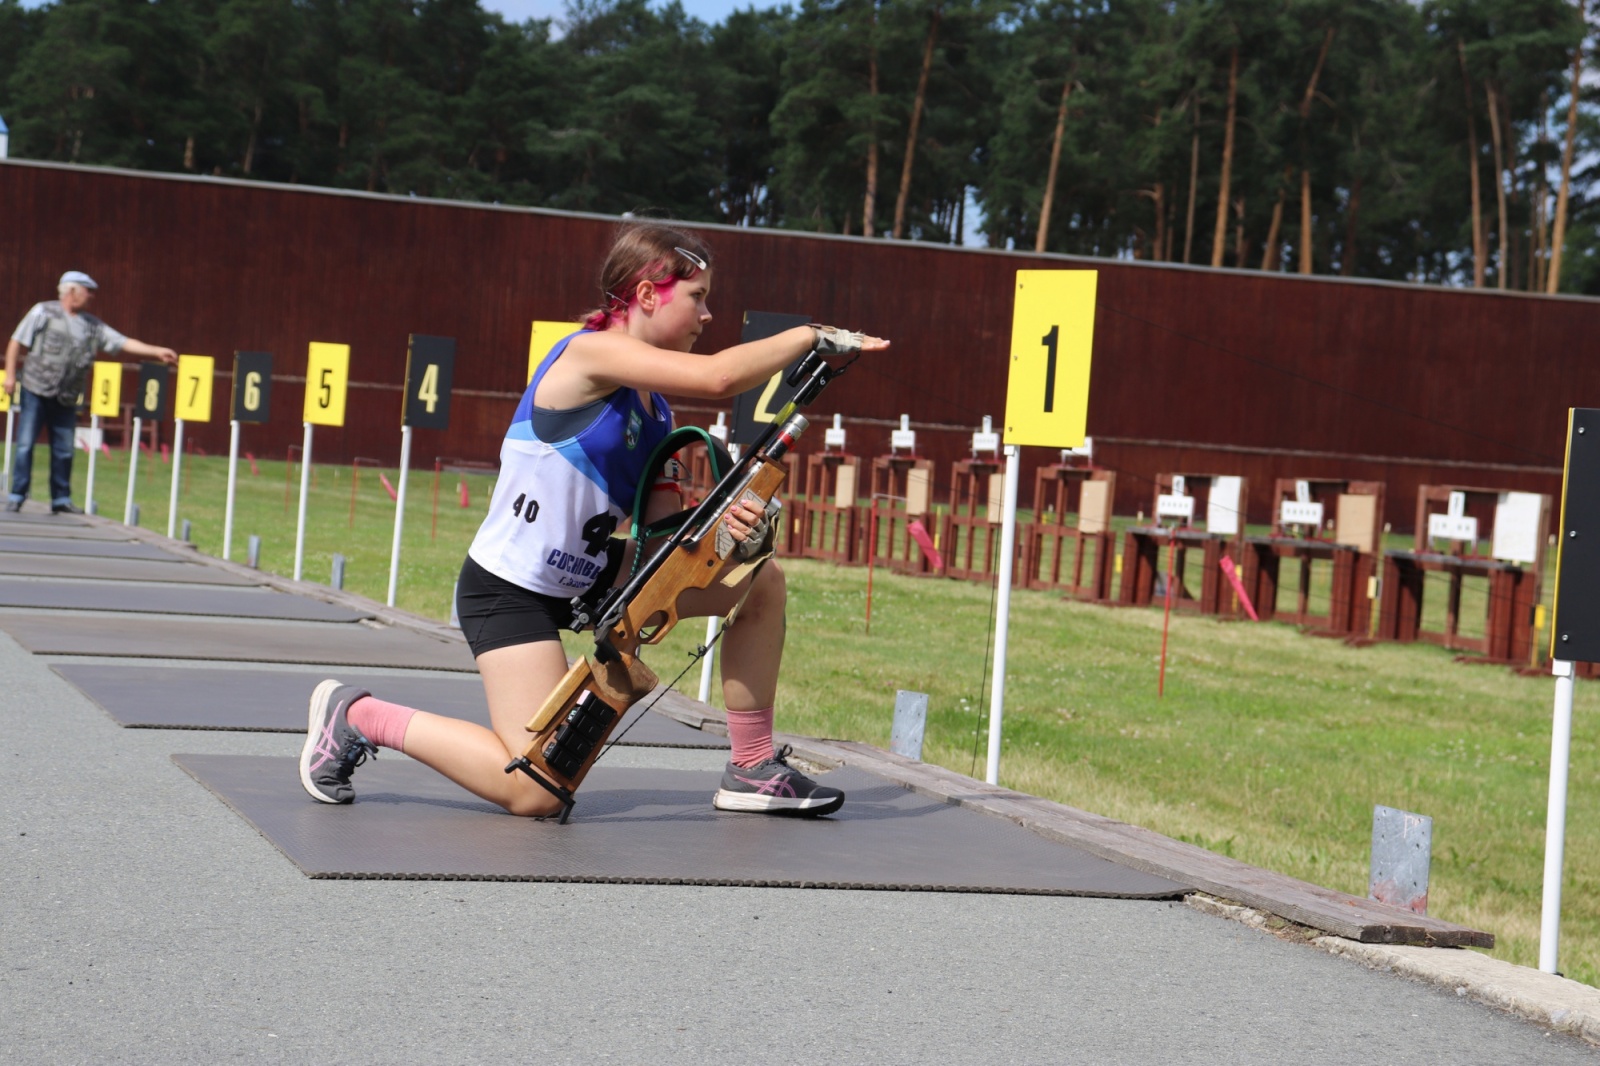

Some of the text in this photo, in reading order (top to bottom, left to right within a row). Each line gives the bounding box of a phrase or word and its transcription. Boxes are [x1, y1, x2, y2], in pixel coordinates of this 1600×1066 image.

[318, 368, 332, 408] 5
[418, 364, 439, 414] 4
[1041, 325, 1059, 413] 1
[101, 378, 112, 406] 9
[143, 378, 160, 412] 8
[188, 376, 200, 408] 7
[243, 371, 262, 411] 6
[753, 370, 783, 423] 2
[512, 492, 540, 524] 40
